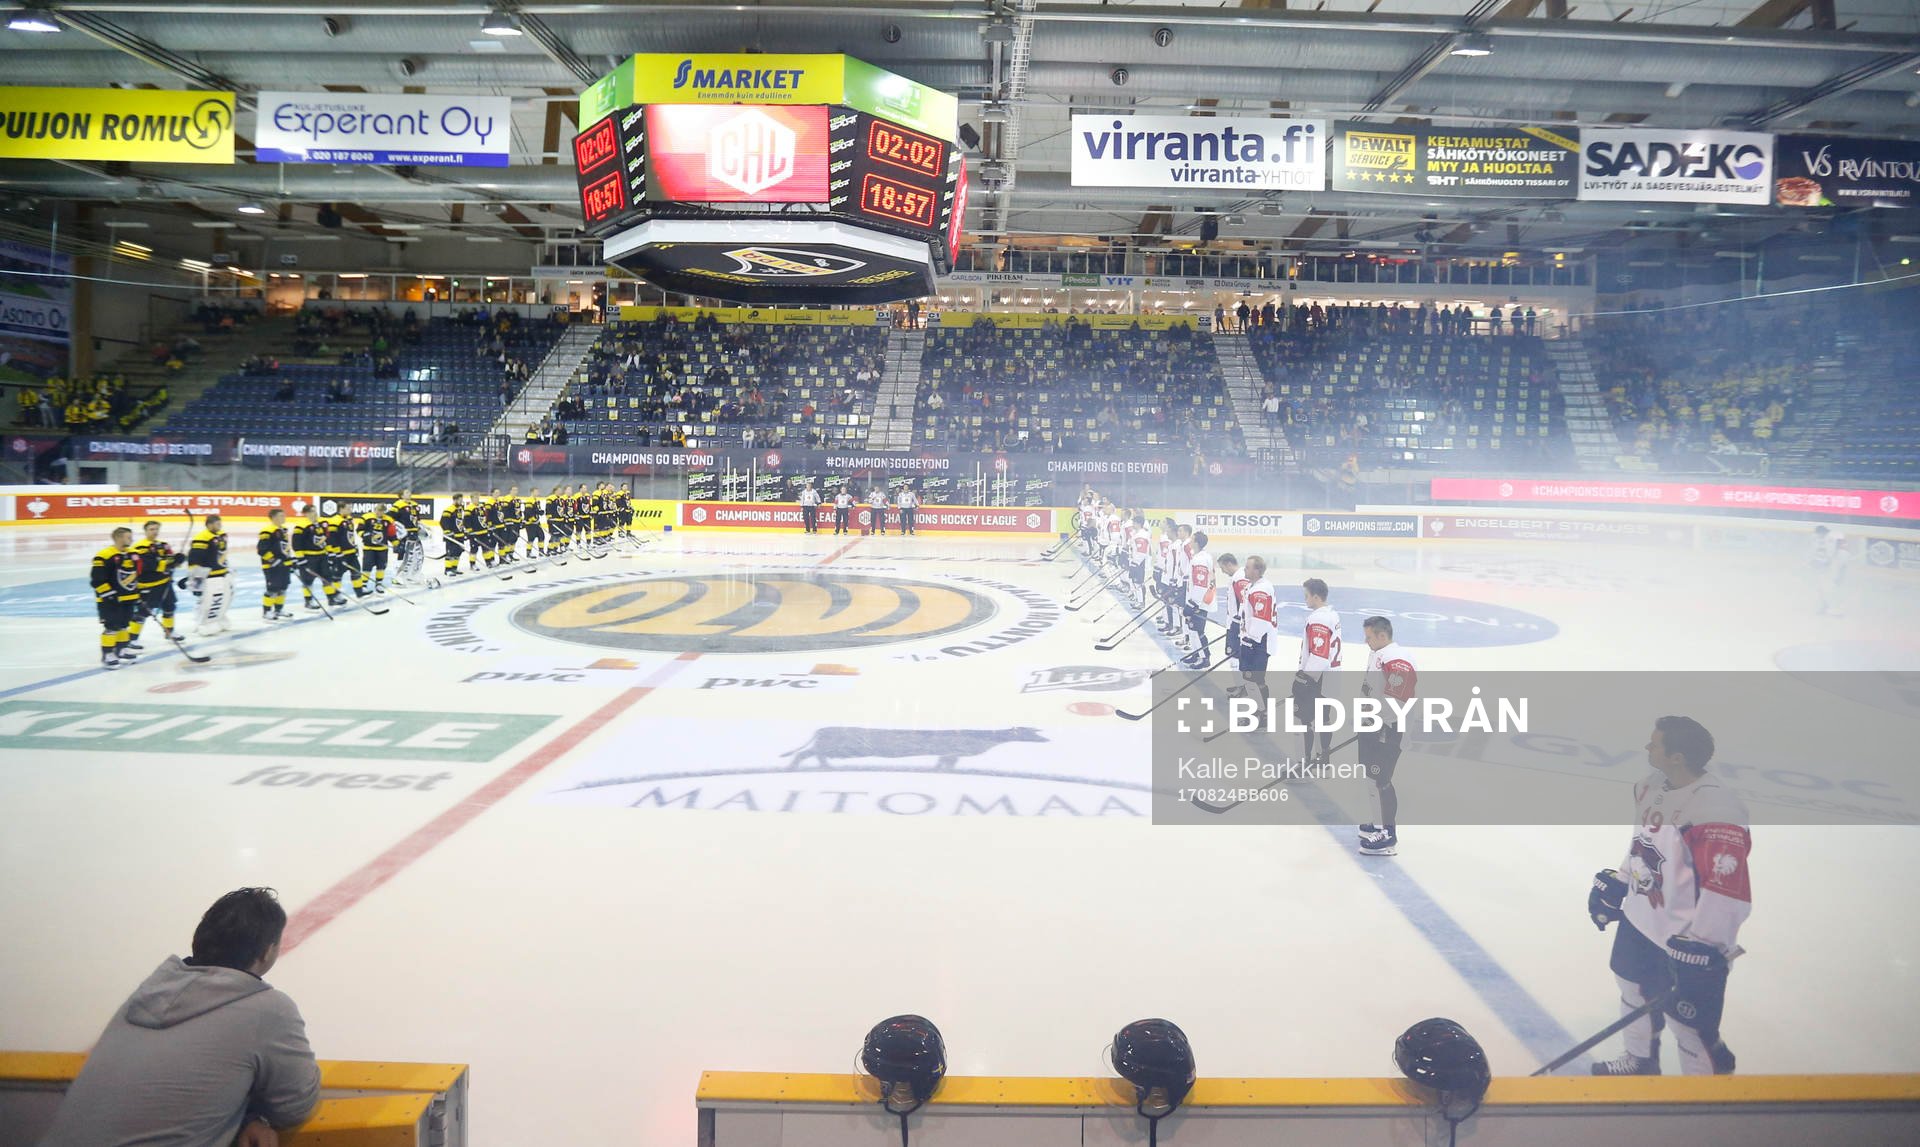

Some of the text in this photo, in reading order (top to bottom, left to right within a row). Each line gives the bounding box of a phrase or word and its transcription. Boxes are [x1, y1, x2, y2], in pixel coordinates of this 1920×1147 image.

[100, 113, 190, 142] ROMU
[274, 104, 493, 145] Experant Oy
[830, 115, 858, 131] SPORT
[580, 128, 612, 166] 02:02
[1083, 120, 1315, 163] virranta.fi
[1427, 135, 1530, 149] KELTAMUSTAT
[719, 124, 787, 176] CHL
[876, 130, 937, 169] 02:02
[1427, 148, 1568, 162] SÄHKÖTYÖKONEET
[388, 153, 463, 164] www.experant.fi
[1350, 153, 1390, 166] SERVICE
[1427, 162, 1554, 175] MYY JA HUOLTAA
[1464, 177, 1524, 186] SÄHKÖHUOLTO
[1584, 181, 1628, 190] LVI-TYÖT
[1630, 182, 1643, 190] JA
[588, 179, 618, 216] 18:57
[870, 183, 930, 218] 18:57
[1105, 277, 1133, 285] YIT
[89, 441, 150, 454] CHAMPIONS
[168, 444, 213, 455] BEYOND
[243, 444, 395, 458] CHAMPIONS HOCKEY LEAGUE
[592, 452, 714, 466] CHAMPIONS GO BEYOND
[767, 454, 780, 465] CHL
[826, 456, 949, 470] #CHAMPIONSGOBEYOND
[1048, 461, 1107, 473] CHAMPIONS
[1127, 463, 1169, 474] BEYOND
[689, 474, 716, 485] SPORT
[66, 496, 281, 507] ENGELBERT STRAUSS
[716, 510, 770, 521] CHAMPIONS
[774, 511, 804, 522] HOCKE
[885, 514, 1017, 526] CHAIONS HOCKEY LEAGUE
[1220, 515, 1282, 526] TISSOT
[1325, 521, 1376, 531] CHAMPIONS
[1456, 518, 1649, 535] ENGELBERT STRAUSS
[460, 671, 586, 684] pwc
[698, 677, 819, 690] pwc
[1509, 732, 1903, 802] Gyroc
[230, 764, 455, 792] forest
[628, 786, 1147, 818] MAITOMAA
